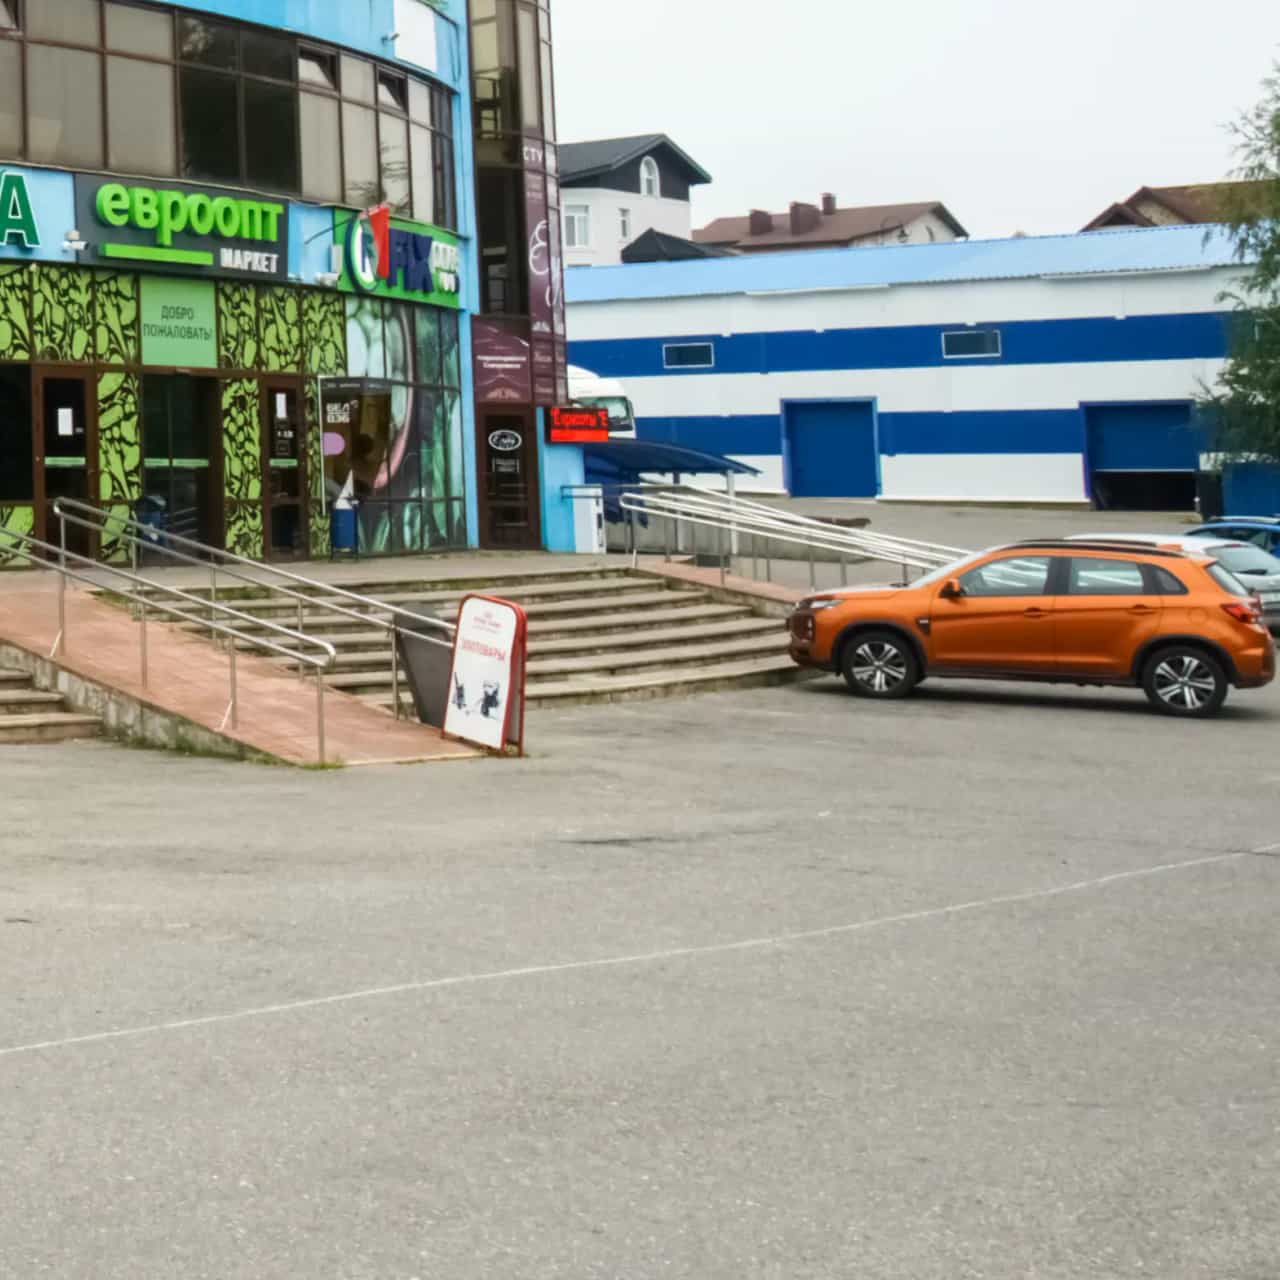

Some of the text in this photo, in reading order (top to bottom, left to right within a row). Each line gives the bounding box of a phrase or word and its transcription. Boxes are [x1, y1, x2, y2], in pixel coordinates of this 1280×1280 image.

[95, 182, 285, 247] евроопт
[219, 247, 280, 273] МАРКЕТ
[161, 304, 195, 321] ДОБРО
